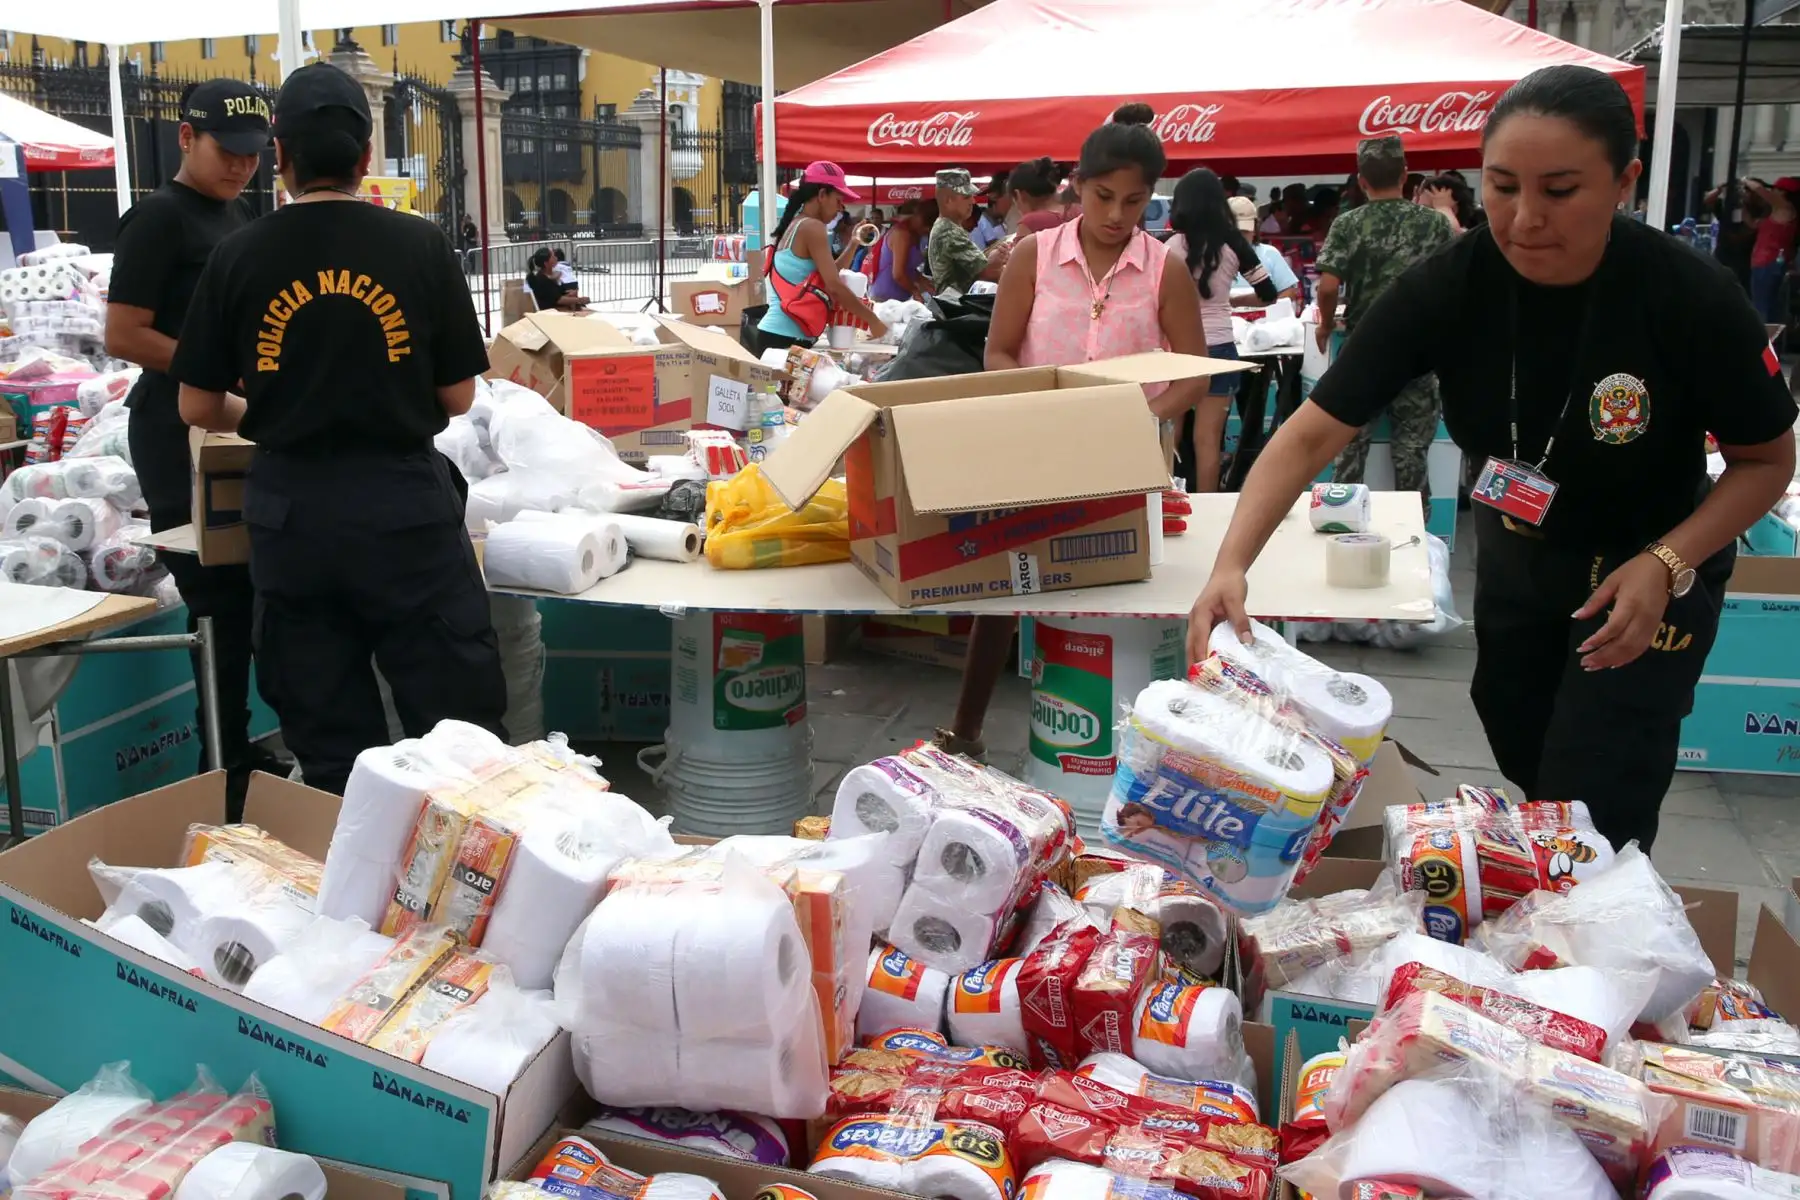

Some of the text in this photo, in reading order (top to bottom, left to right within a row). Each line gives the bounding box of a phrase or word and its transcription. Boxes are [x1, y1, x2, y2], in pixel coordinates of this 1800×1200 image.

[189, 108, 208, 119] PERU
[867, 111, 980, 147] Coca-Cola
[257, 269, 411, 372] POLICIA NACIONAL
[714, 386, 741, 401] GALLETA
[718, 401, 735, 414] SODA
[911, 582, 984, 600] PREMIUM
[1142, 774, 1244, 840] Elite
[465, 871, 492, 891] aro
[1424, 862, 1450, 893] 50
[396, 889, 420, 910] aro
[440, 984, 469, 1001] aro
[1050, 977, 1066, 1027] SAN JORGE
[1106, 1012, 1118, 1031] SAN
[1074, 1075, 1094, 1092] SAN
[1143, 1116, 1200, 1134] SODA
[957, 1138, 995, 1158] 50
